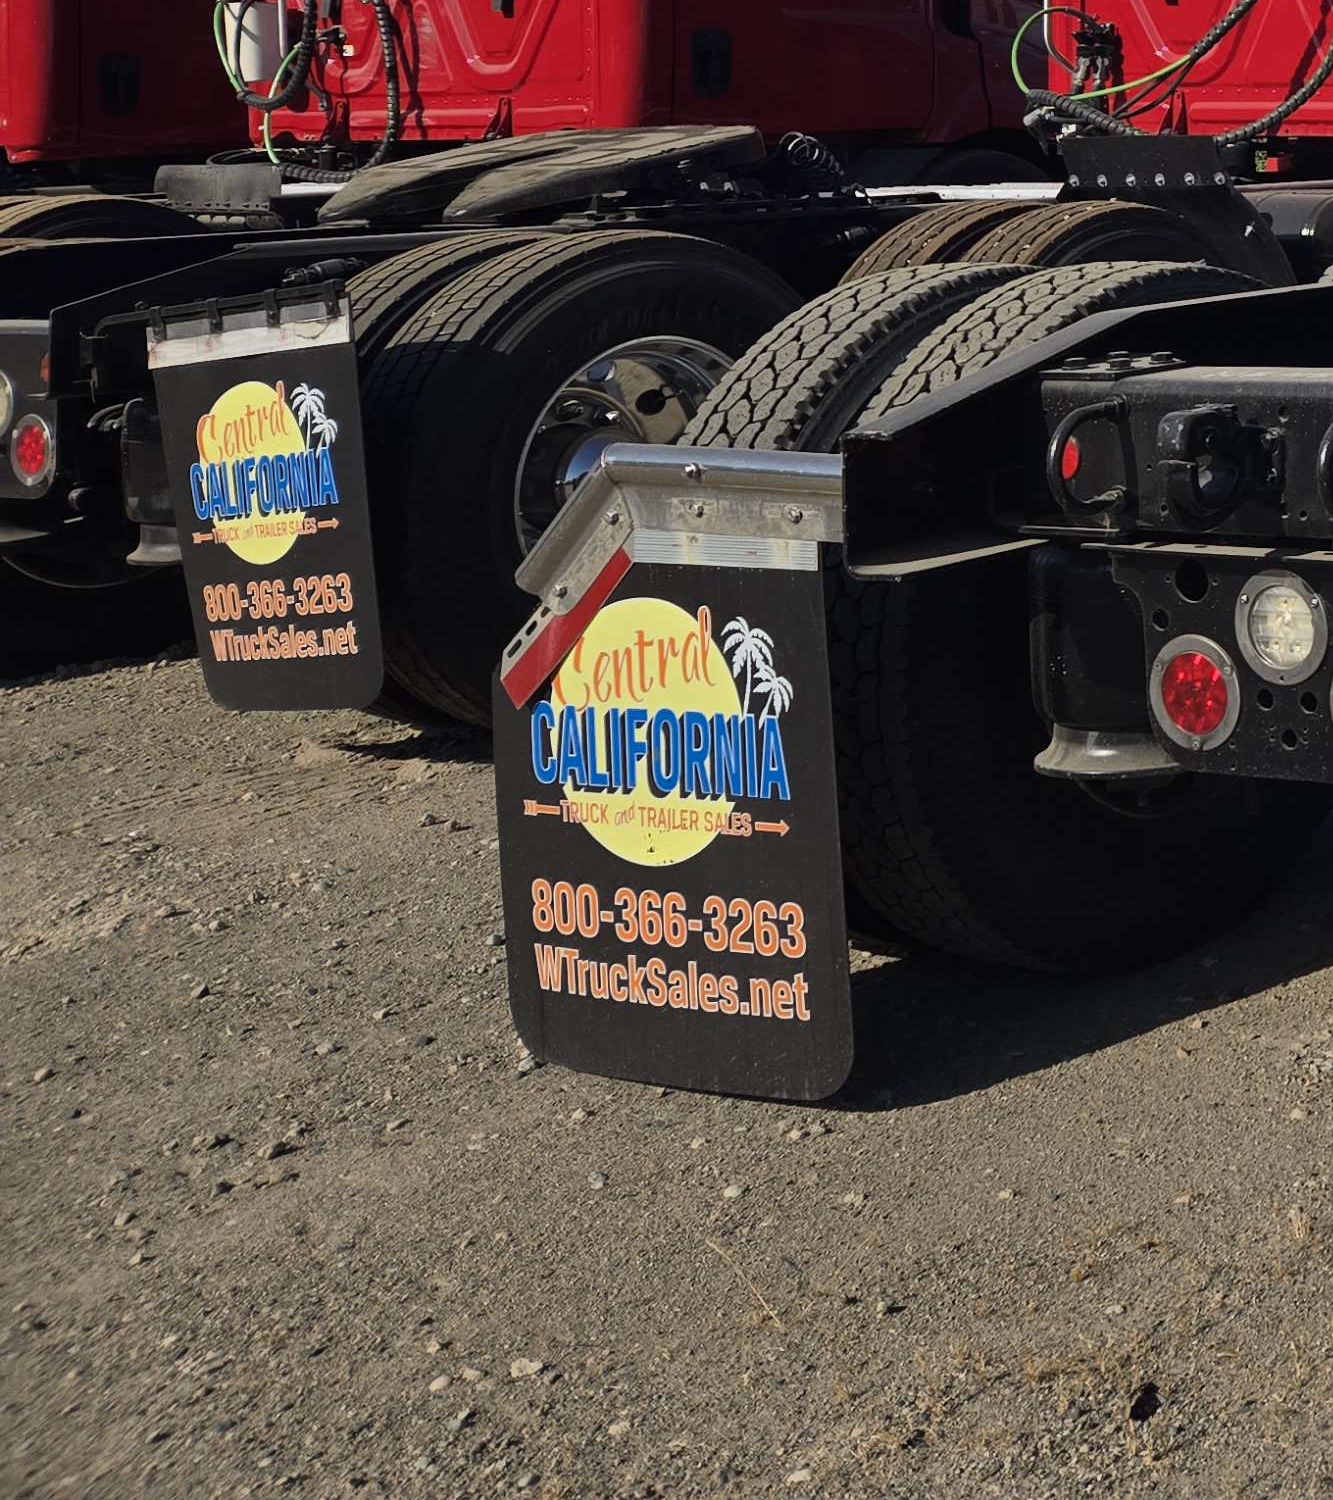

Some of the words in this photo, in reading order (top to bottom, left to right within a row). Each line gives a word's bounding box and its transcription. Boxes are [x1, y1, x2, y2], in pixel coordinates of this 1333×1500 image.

[196, 379, 290, 467] Central
[190, 447, 338, 520] CALIFORNIA
[211, 524, 239, 544] TRUCK
[254, 516, 288, 539] TRAILER
[288, 516, 318, 536] SALES
[203, 572, 353, 622] 800-366-3263
[210, 620, 358, 662] WTruckSales.net
[552, 604, 717, 714] Central
[531, 700, 790, 800] CALIFORNIA
[560, 799, 609, 825] TRUCK
[614, 799, 635, 825] and
[638, 805, 699, 833] TRAILER
[703, 811, 752, 838] SALES
[531, 878, 806, 959] 800-366-3263
[534, 942, 810, 1021] WTruckSales.net
